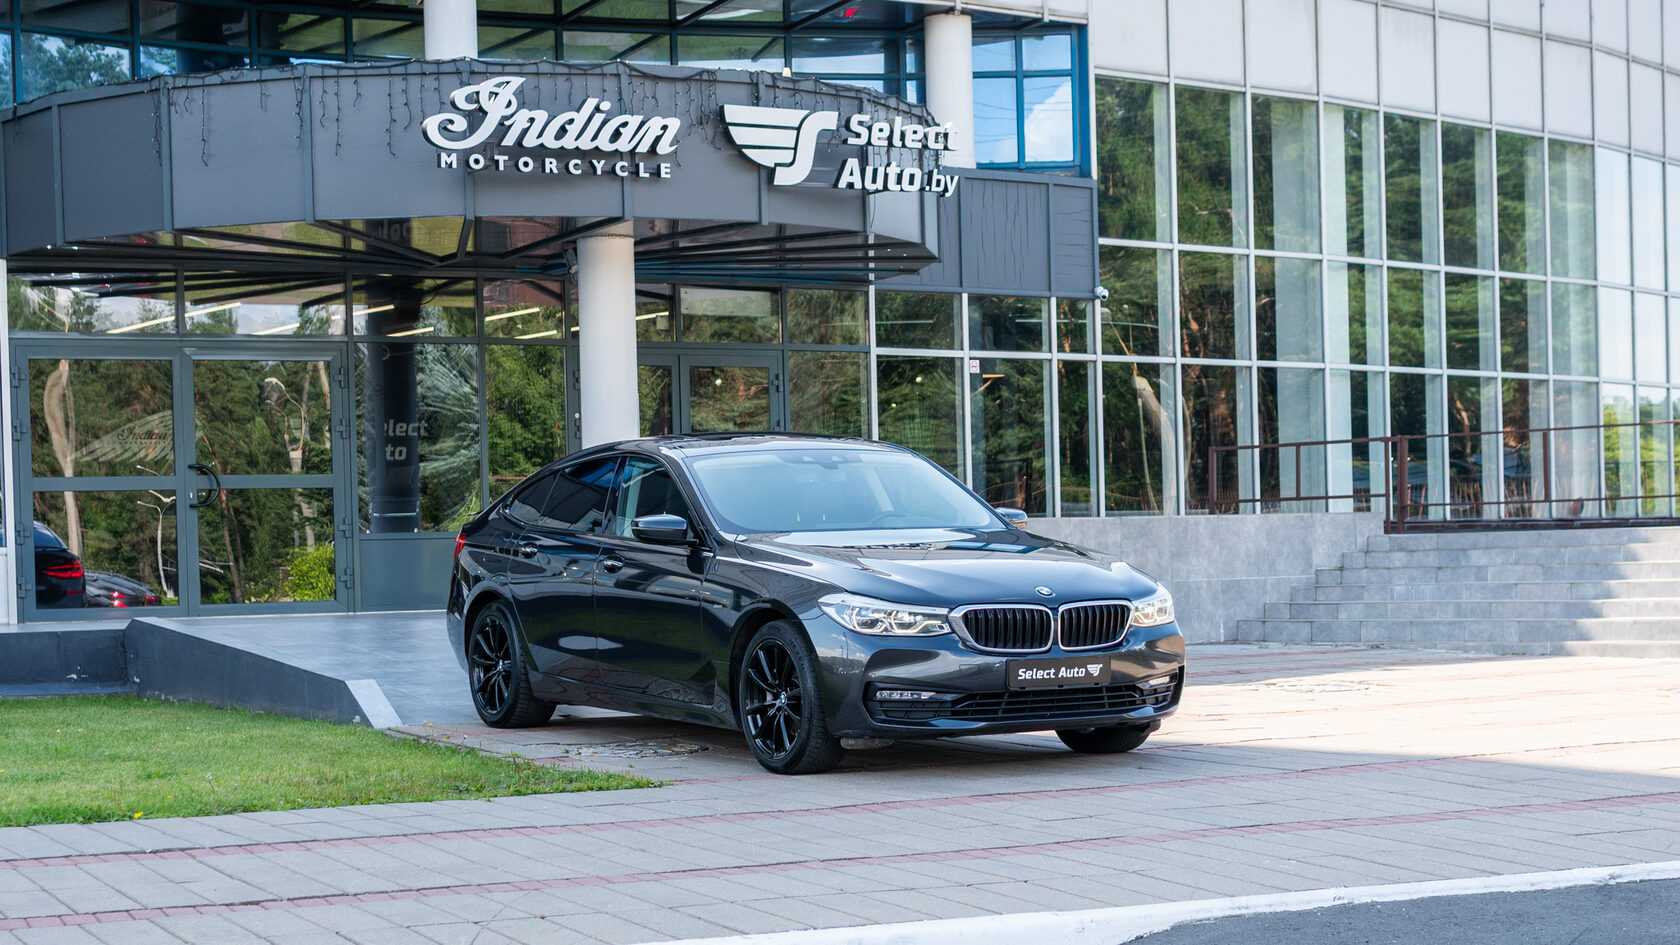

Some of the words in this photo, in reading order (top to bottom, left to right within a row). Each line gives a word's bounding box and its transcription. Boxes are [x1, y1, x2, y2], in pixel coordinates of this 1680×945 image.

[422, 76, 681, 155] Indian
[846, 113, 960, 150] Select
[439, 152, 672, 179] MOTORCYCLE
[837, 158, 960, 198] Auto.by
[384, 419, 428, 437] lect
[1018, 668, 1055, 680] Select
[1058, 666, 1086, 678] Auto
